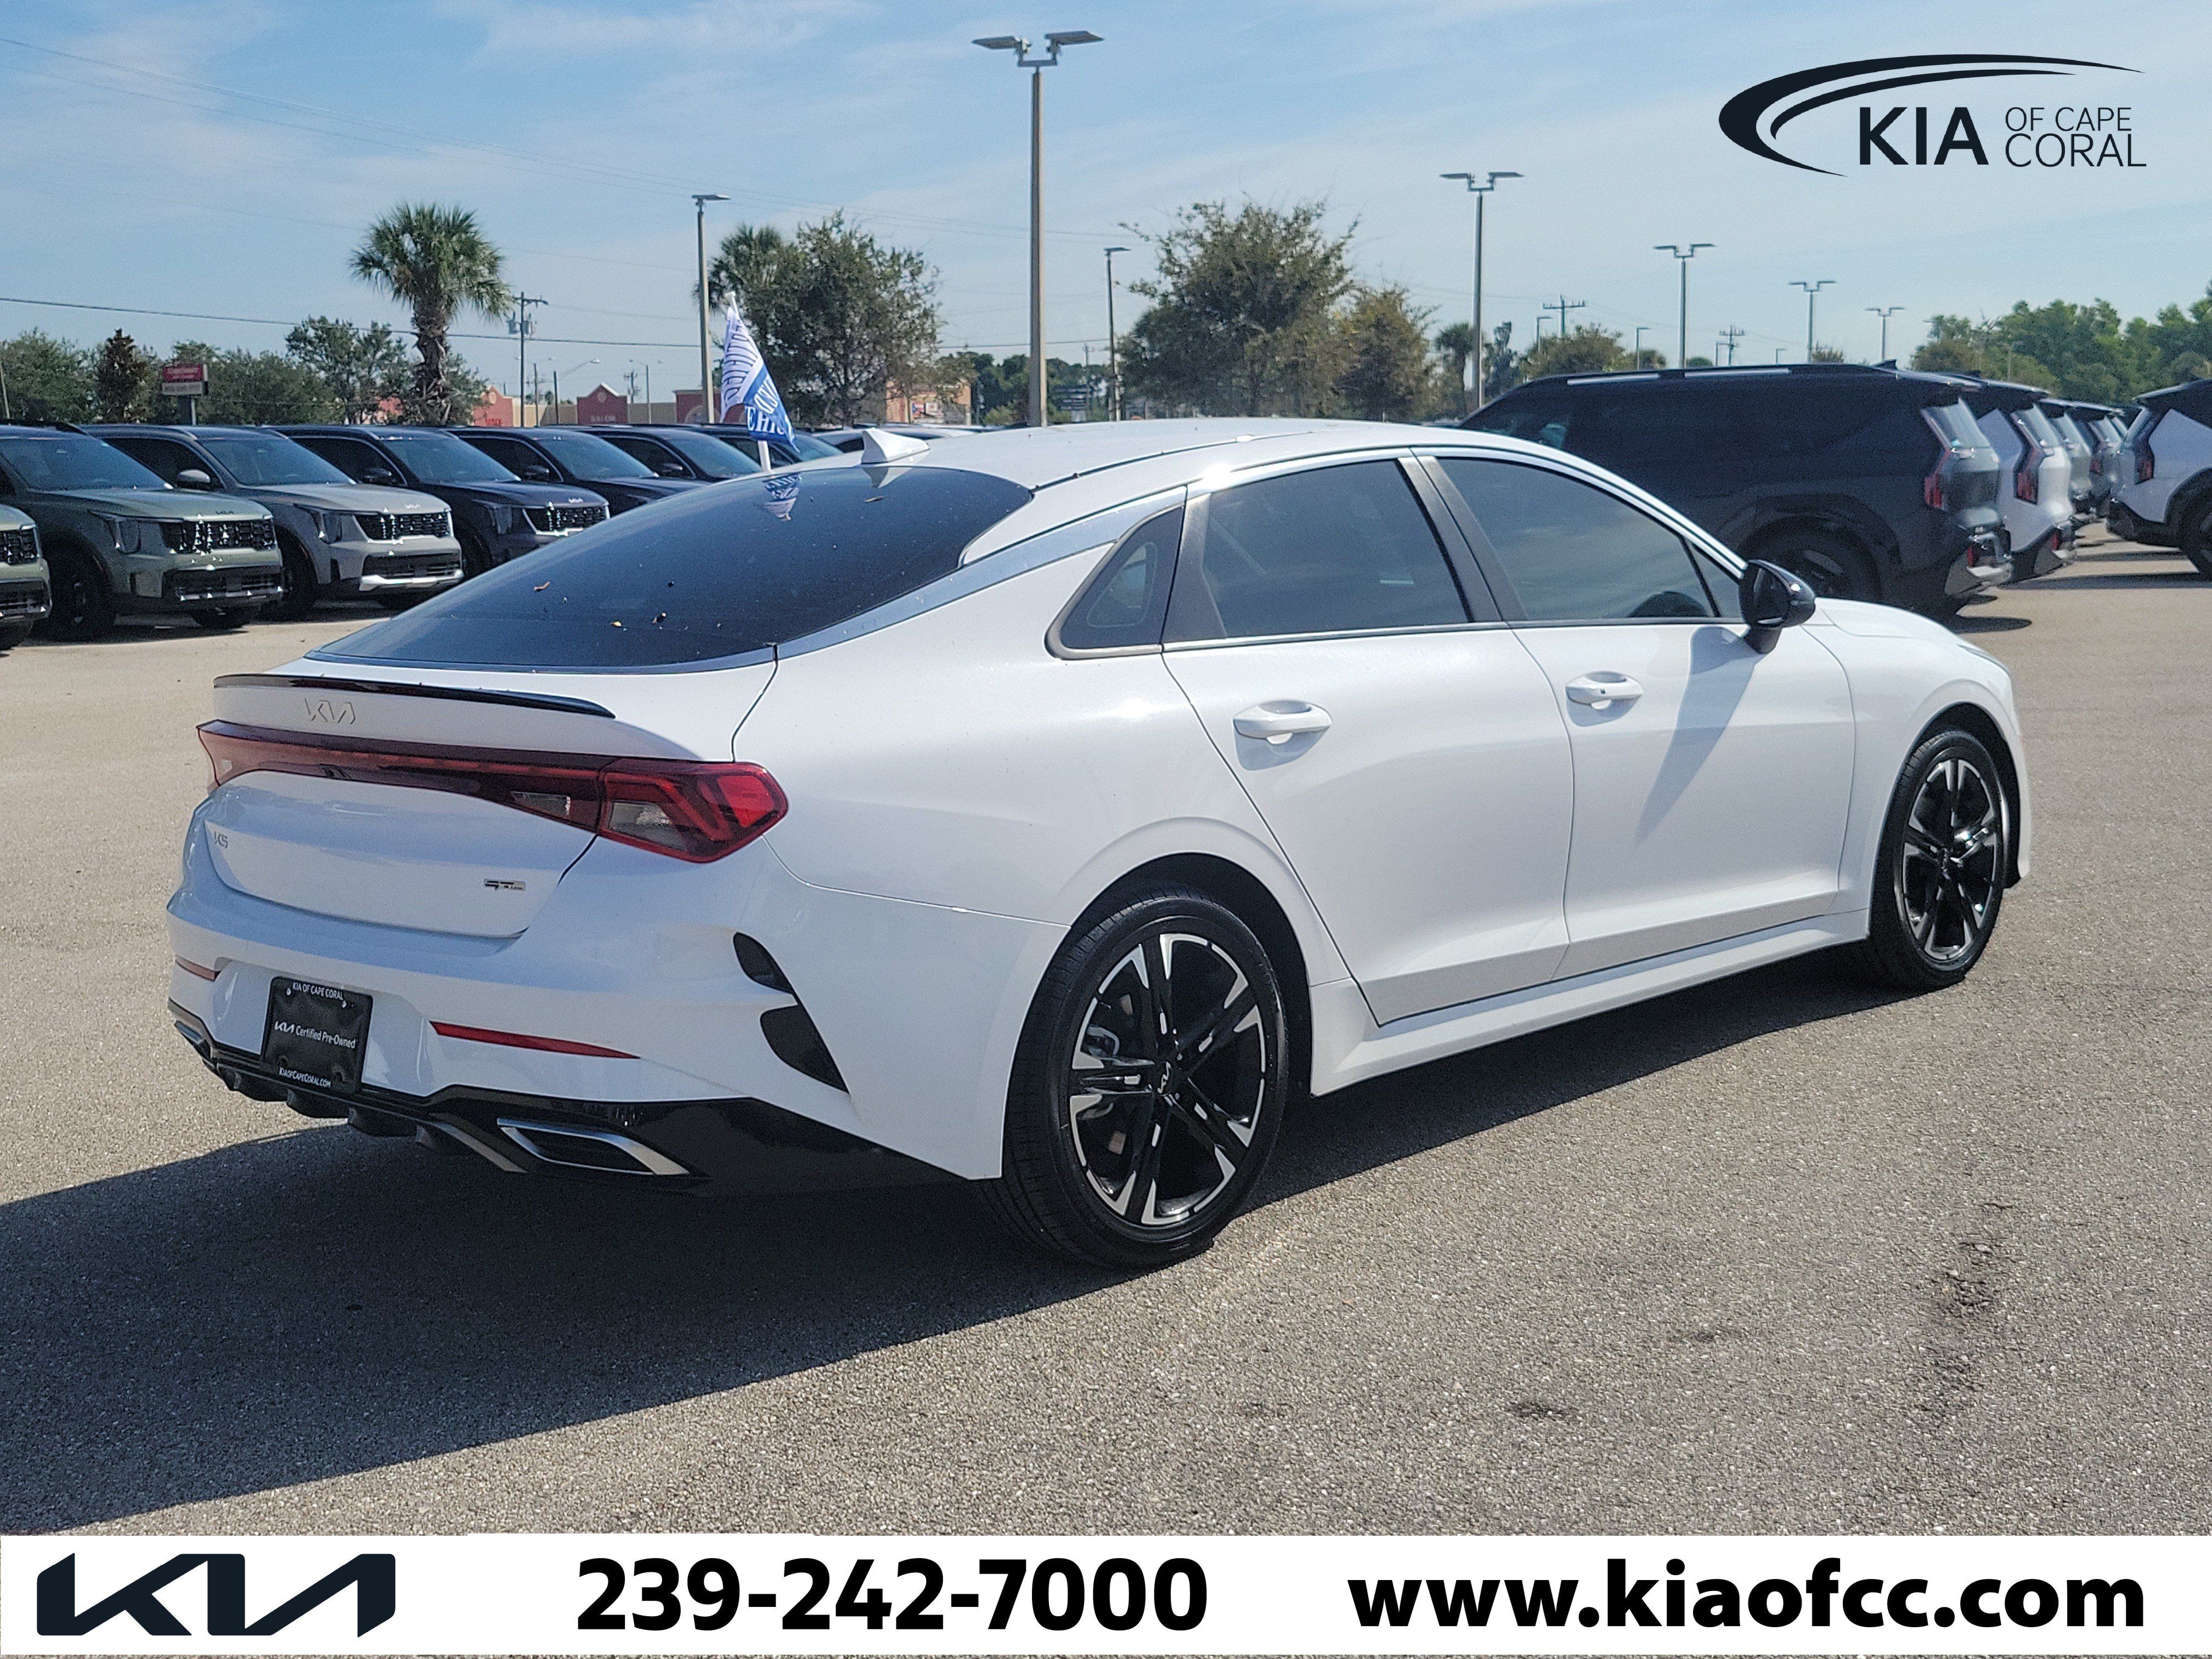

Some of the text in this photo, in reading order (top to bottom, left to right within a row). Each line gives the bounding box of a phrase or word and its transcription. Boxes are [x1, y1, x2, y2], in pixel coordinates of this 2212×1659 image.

[292, 981, 343, 1001] KIA OF CAPE CORAL
[296, 1025, 322, 1041] Certified
[321, 1031, 356, 1049] Pre-Owned
